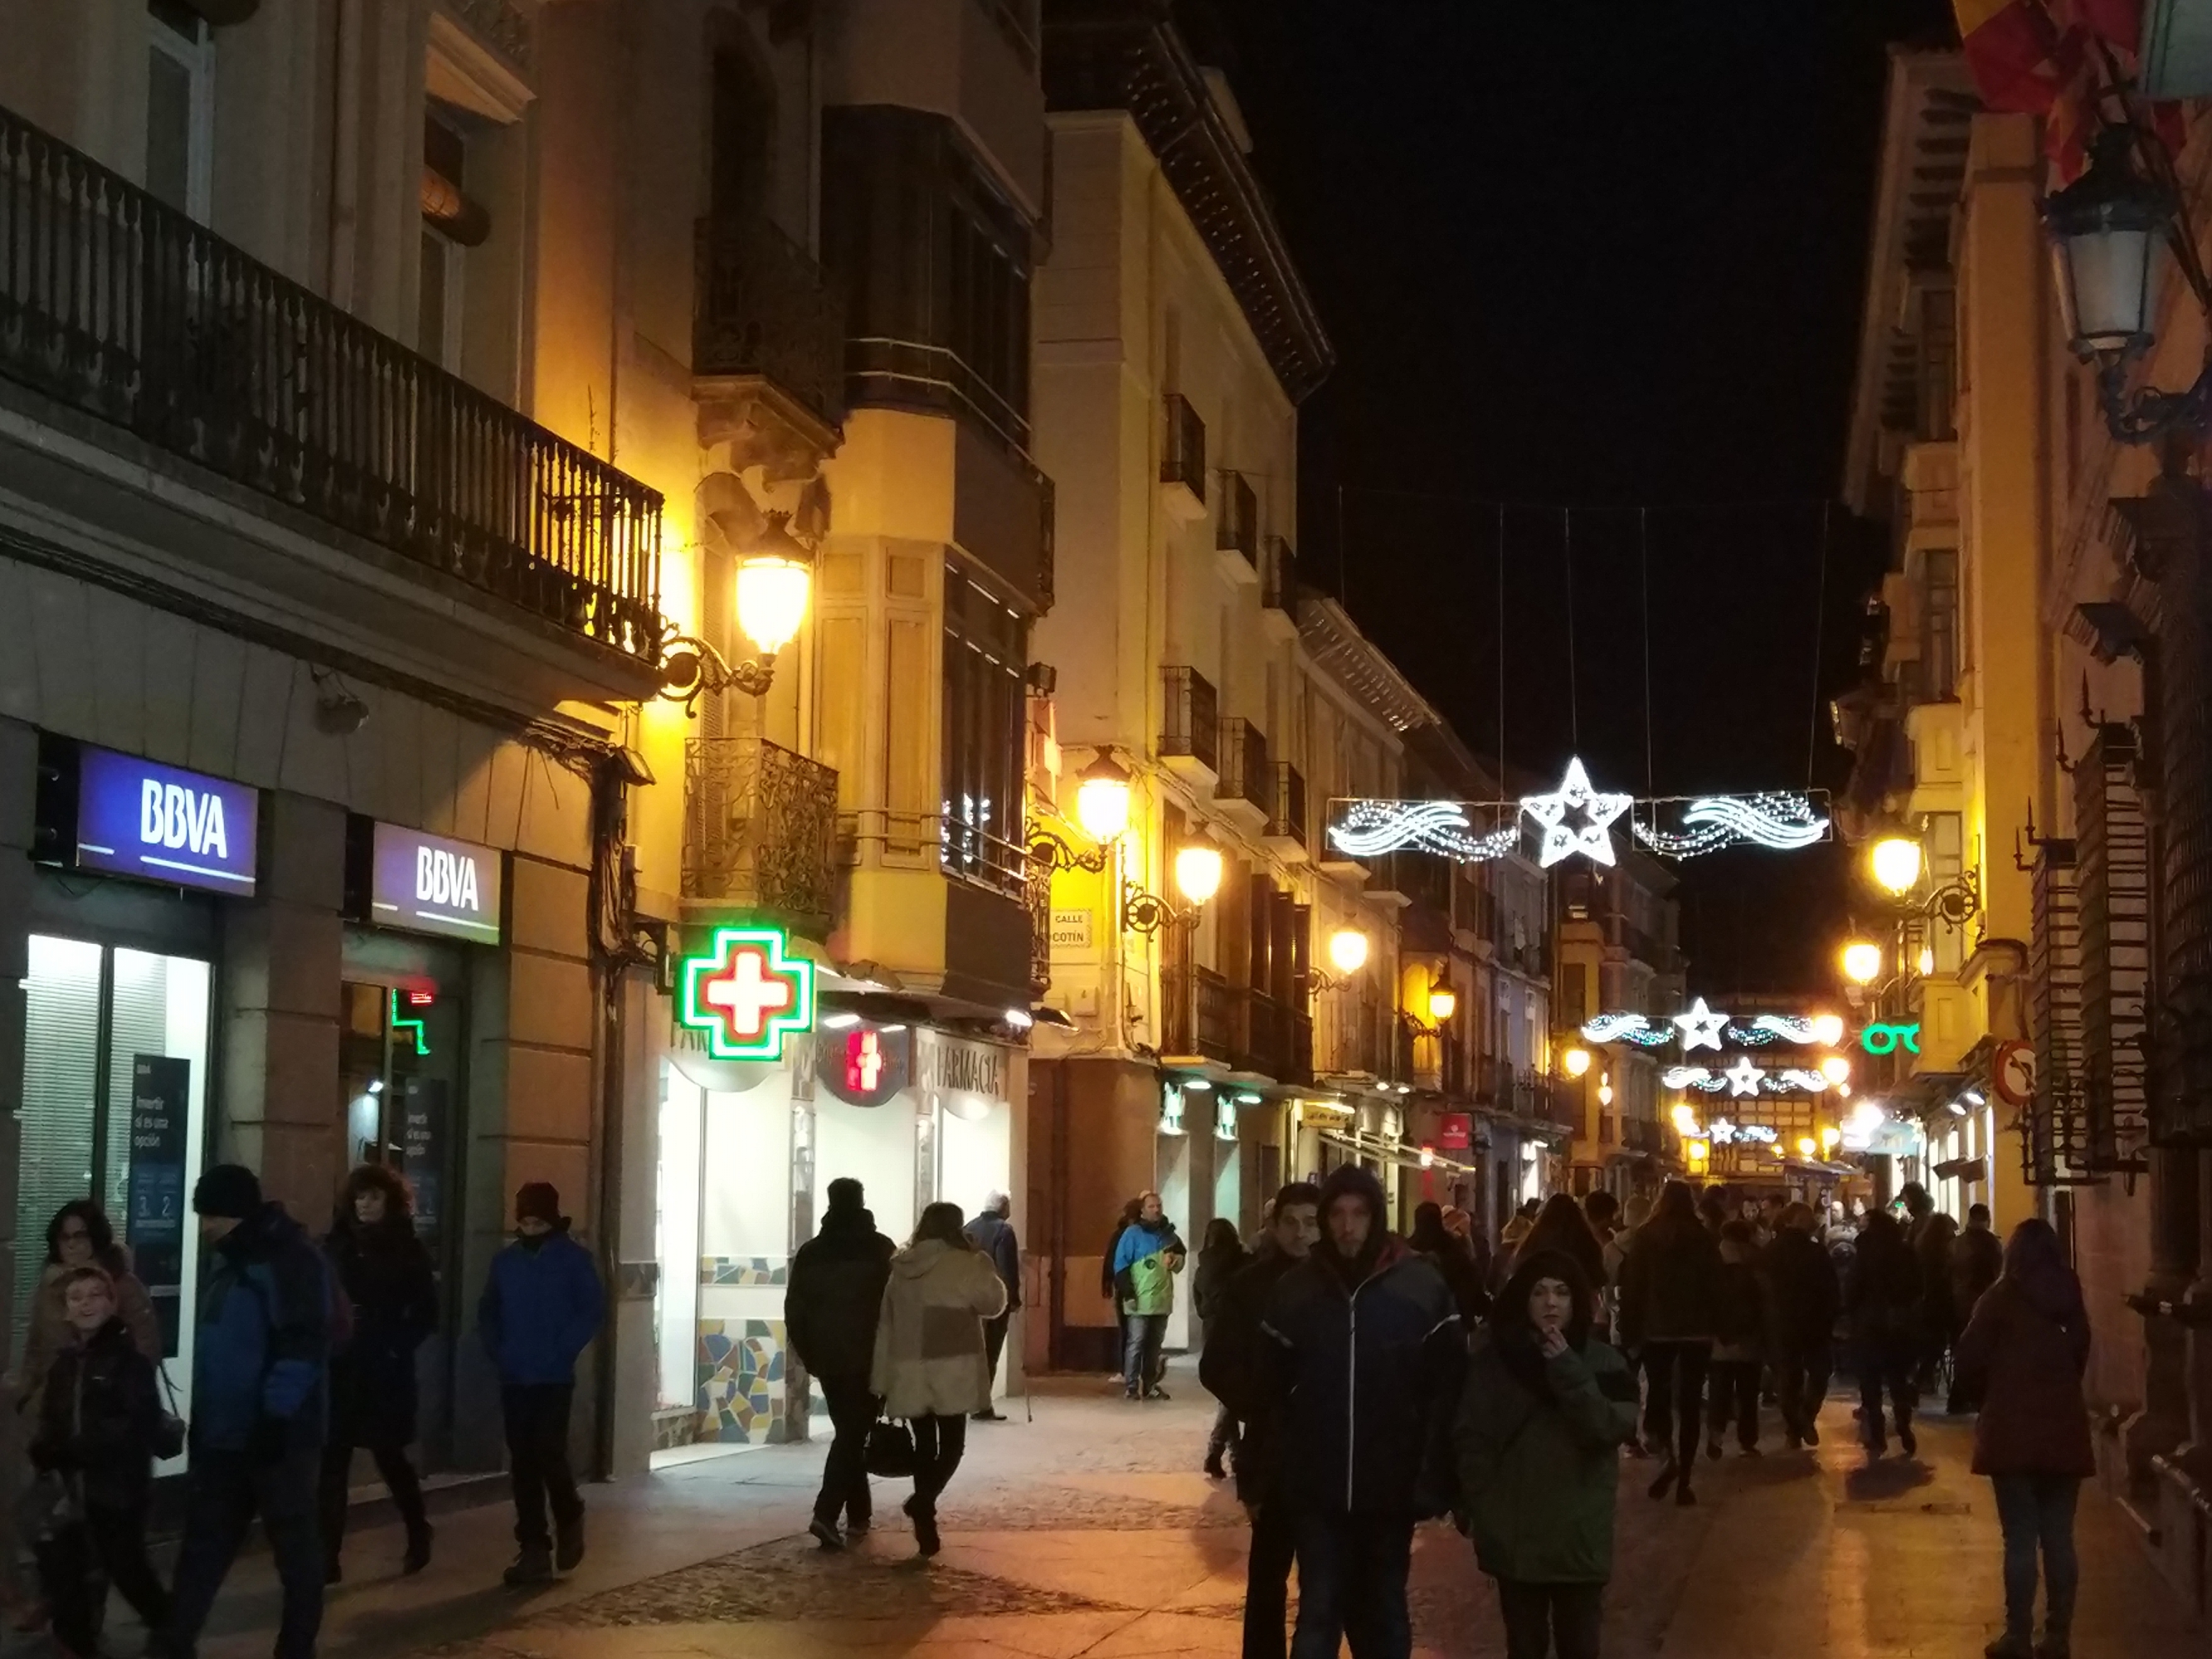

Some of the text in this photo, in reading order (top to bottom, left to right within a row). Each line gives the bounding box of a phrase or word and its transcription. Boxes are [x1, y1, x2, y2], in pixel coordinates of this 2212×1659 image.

[140, 778, 227, 859] BBVA
[416, 845, 479, 912] BBVA
[1055, 915, 1083, 923] CALLE
[936, 1045, 999, 1097] FARMACIA
